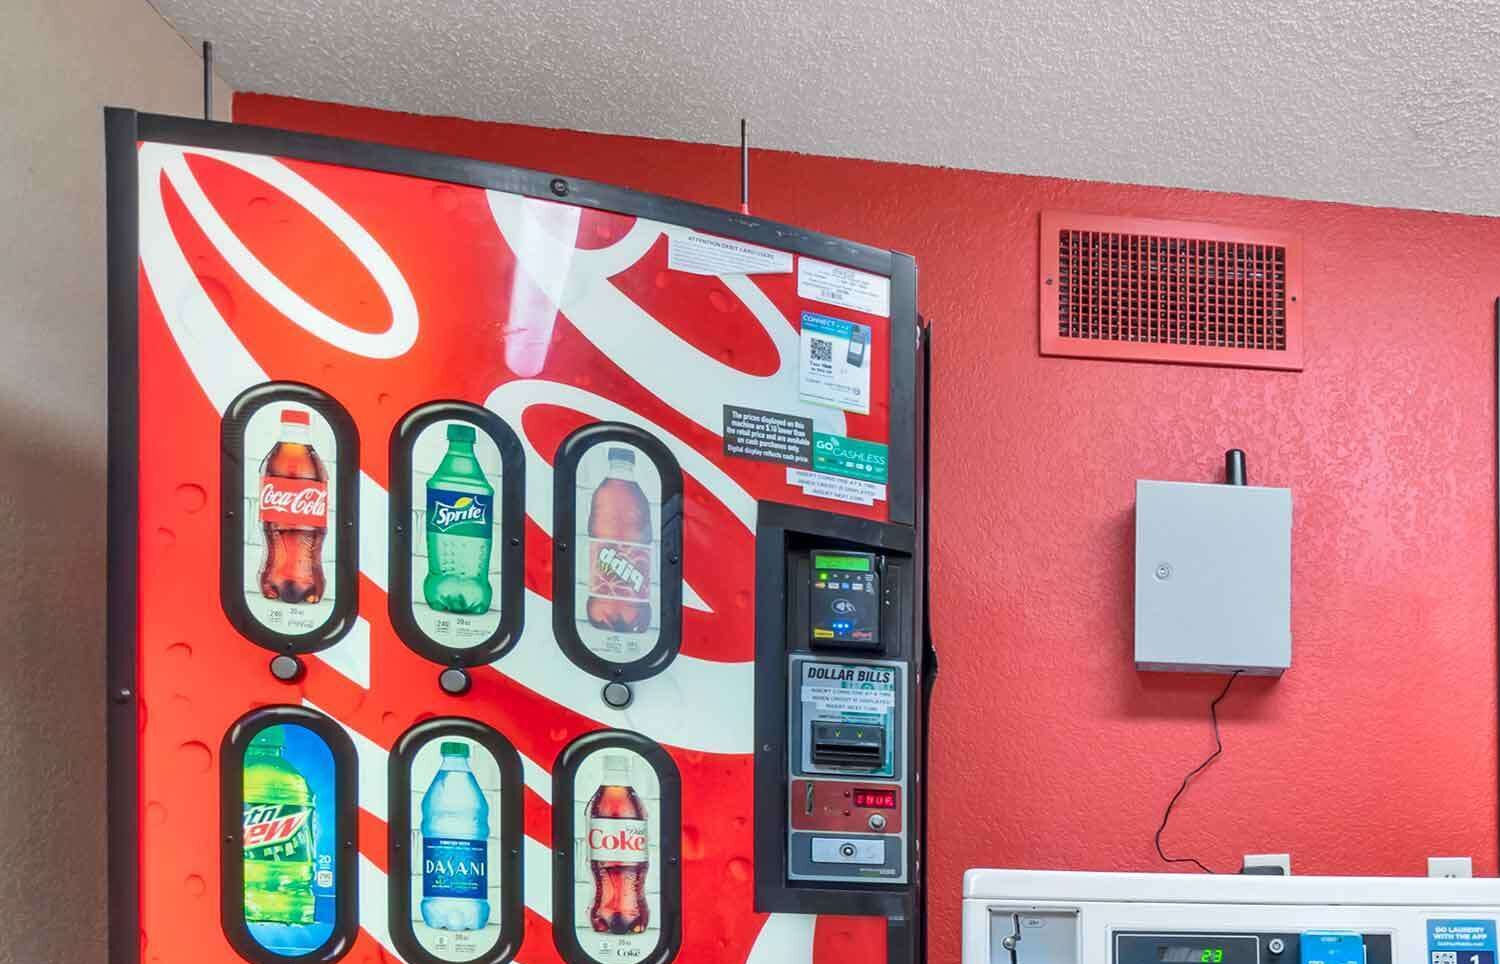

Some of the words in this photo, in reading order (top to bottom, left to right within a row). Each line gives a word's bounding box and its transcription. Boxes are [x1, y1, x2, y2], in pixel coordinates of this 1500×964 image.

[816, 440, 833, 450] GO
[260, 483, 328, 516] Coca-Cola
[436, 504, 482, 526] Sprite
[808, 667, 855, 681] DOLLAR
[857, 670, 891, 683] BILLS
[588, 828, 646, 851] Coke
[319, 855, 332, 864] 20
[425, 857, 485, 876] DASANI
[1201, 948, 1224, 963] 23
